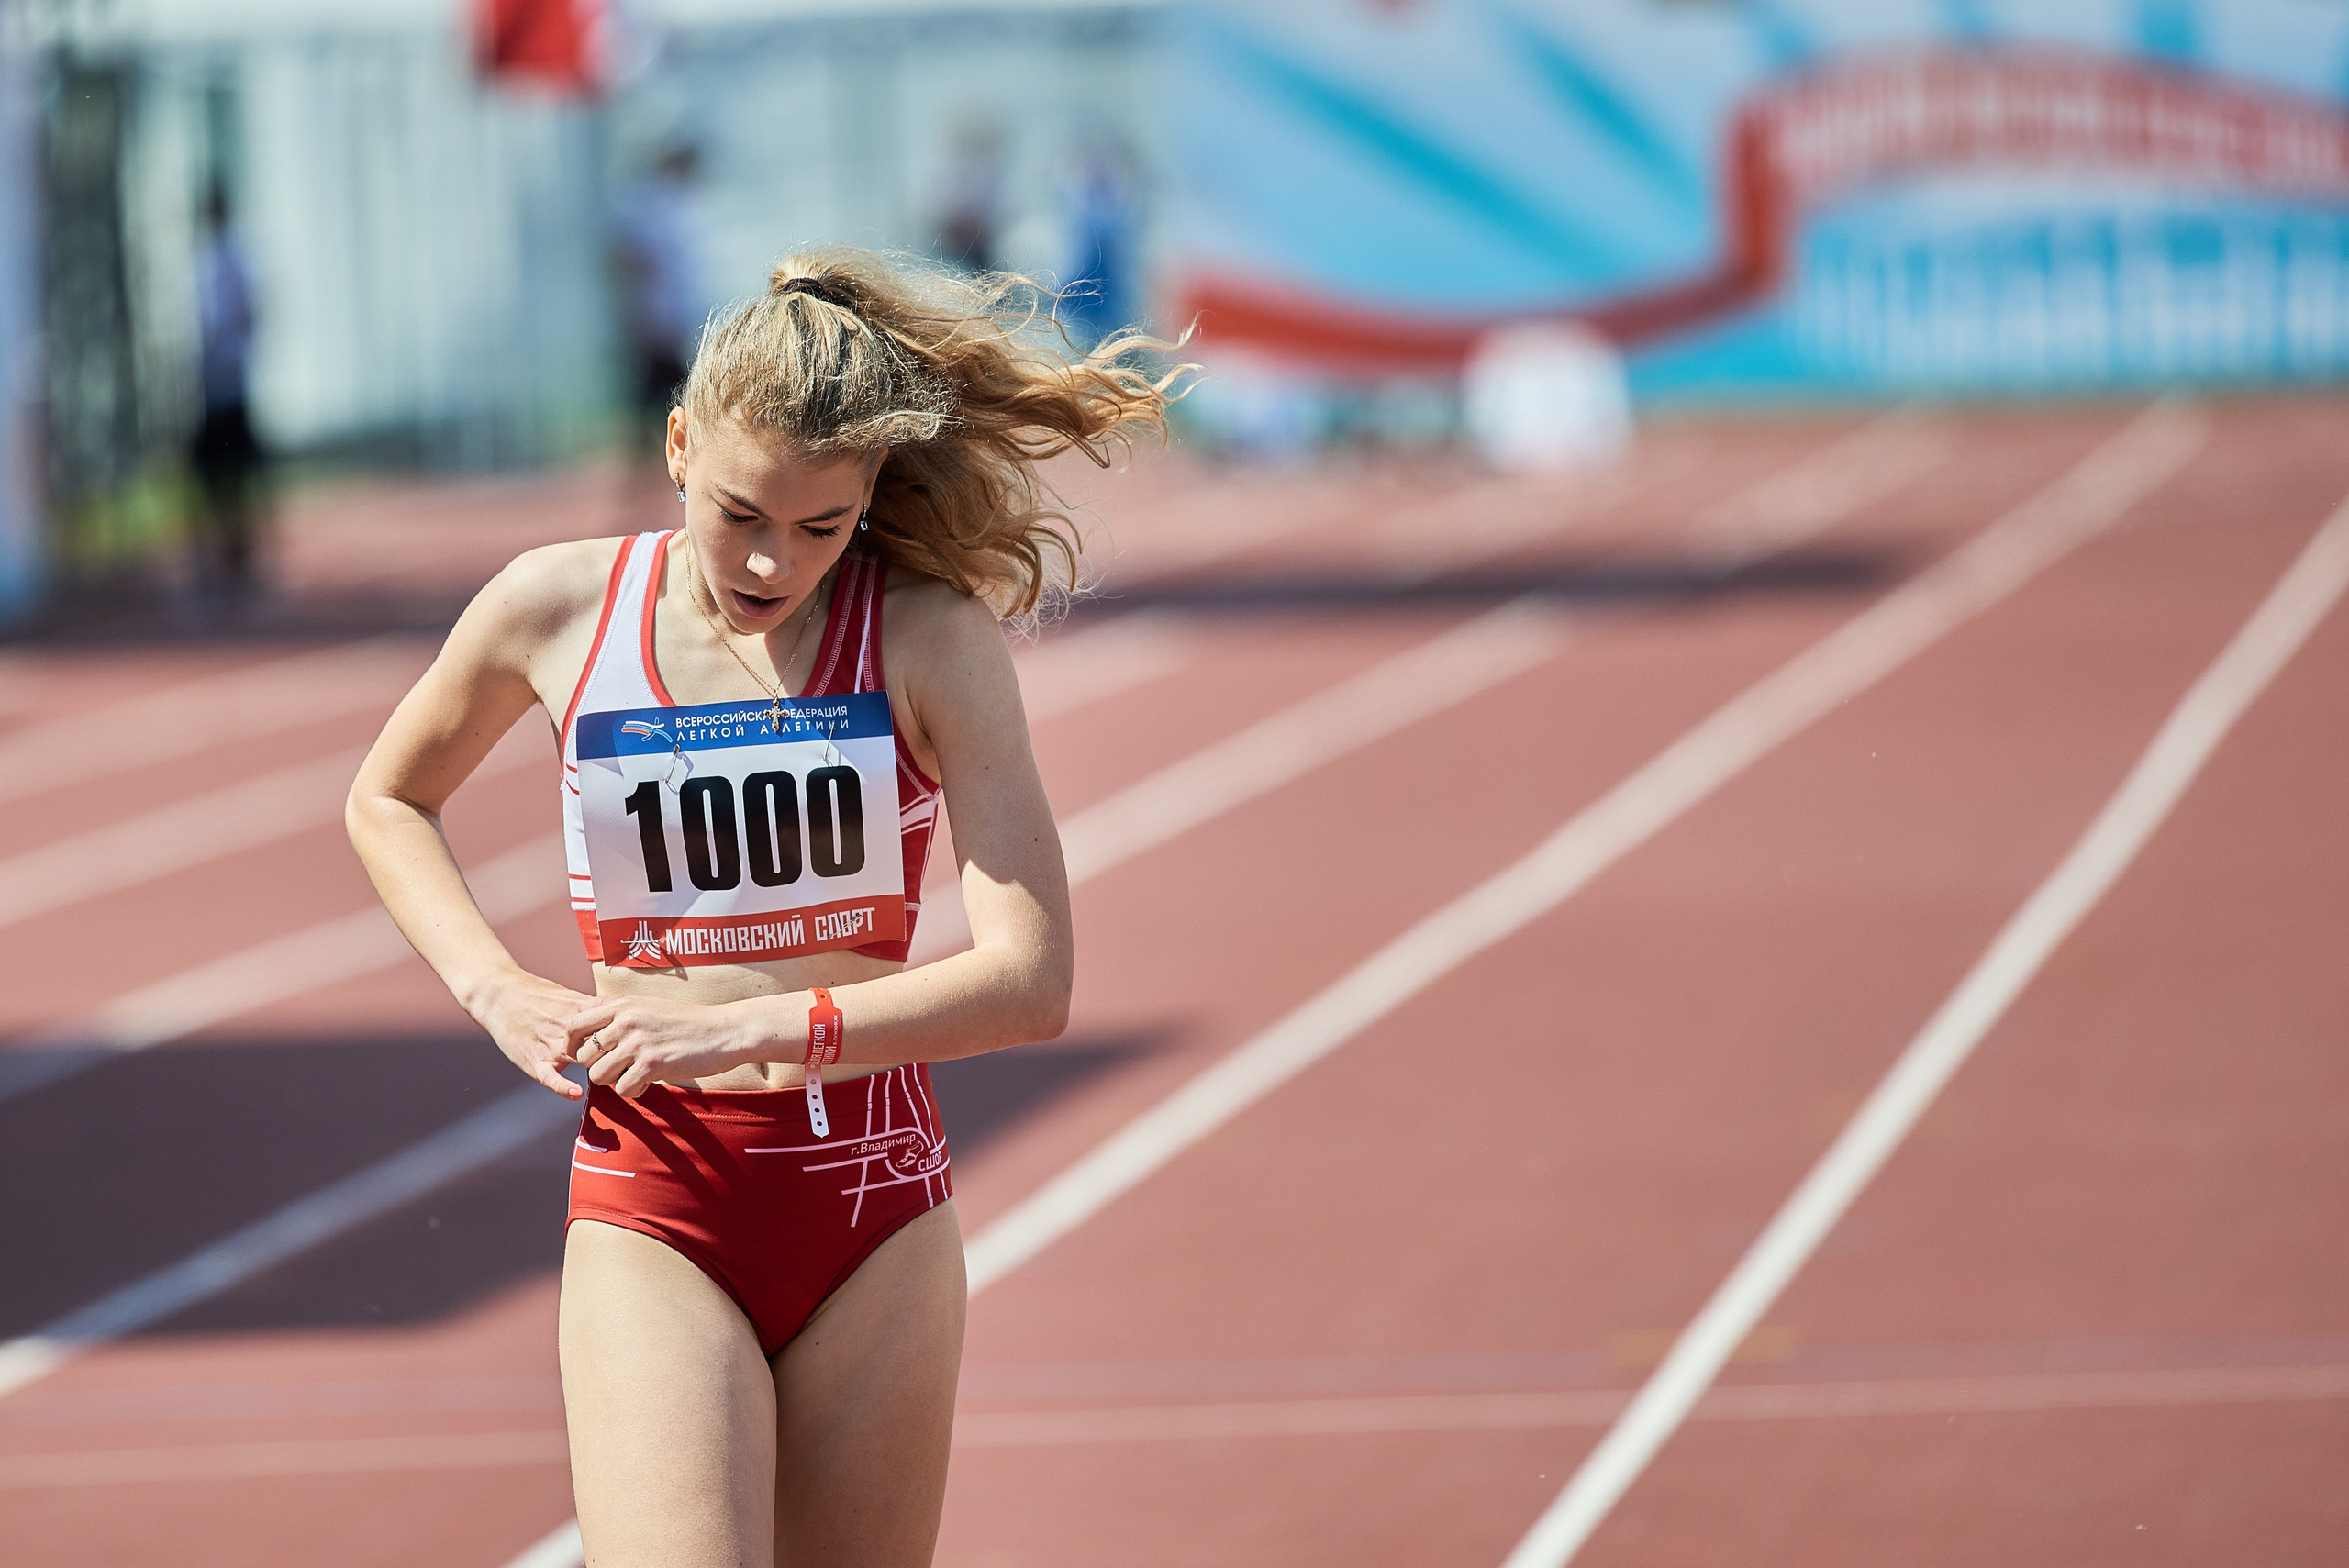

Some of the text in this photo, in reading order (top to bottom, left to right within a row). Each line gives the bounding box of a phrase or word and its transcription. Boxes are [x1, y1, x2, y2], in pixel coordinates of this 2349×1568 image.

[675, 706, 848, 728] ВСЕРОССИЙСКА ЕДЕРАЦИЯ
[676, 719, 850, 741] ЛЕГКОЙ АЛЕТИКИ
[625, 765, 865, 892] 1000
[665, 906, 875, 956] МОСКОВСКИЙ СПОРТ
[812, 1024, 826, 1054] ЛЕГКОЙ
[821, 1046, 837, 1064] ЕТИКИ
[918, 1151, 942, 1172] СШОР
